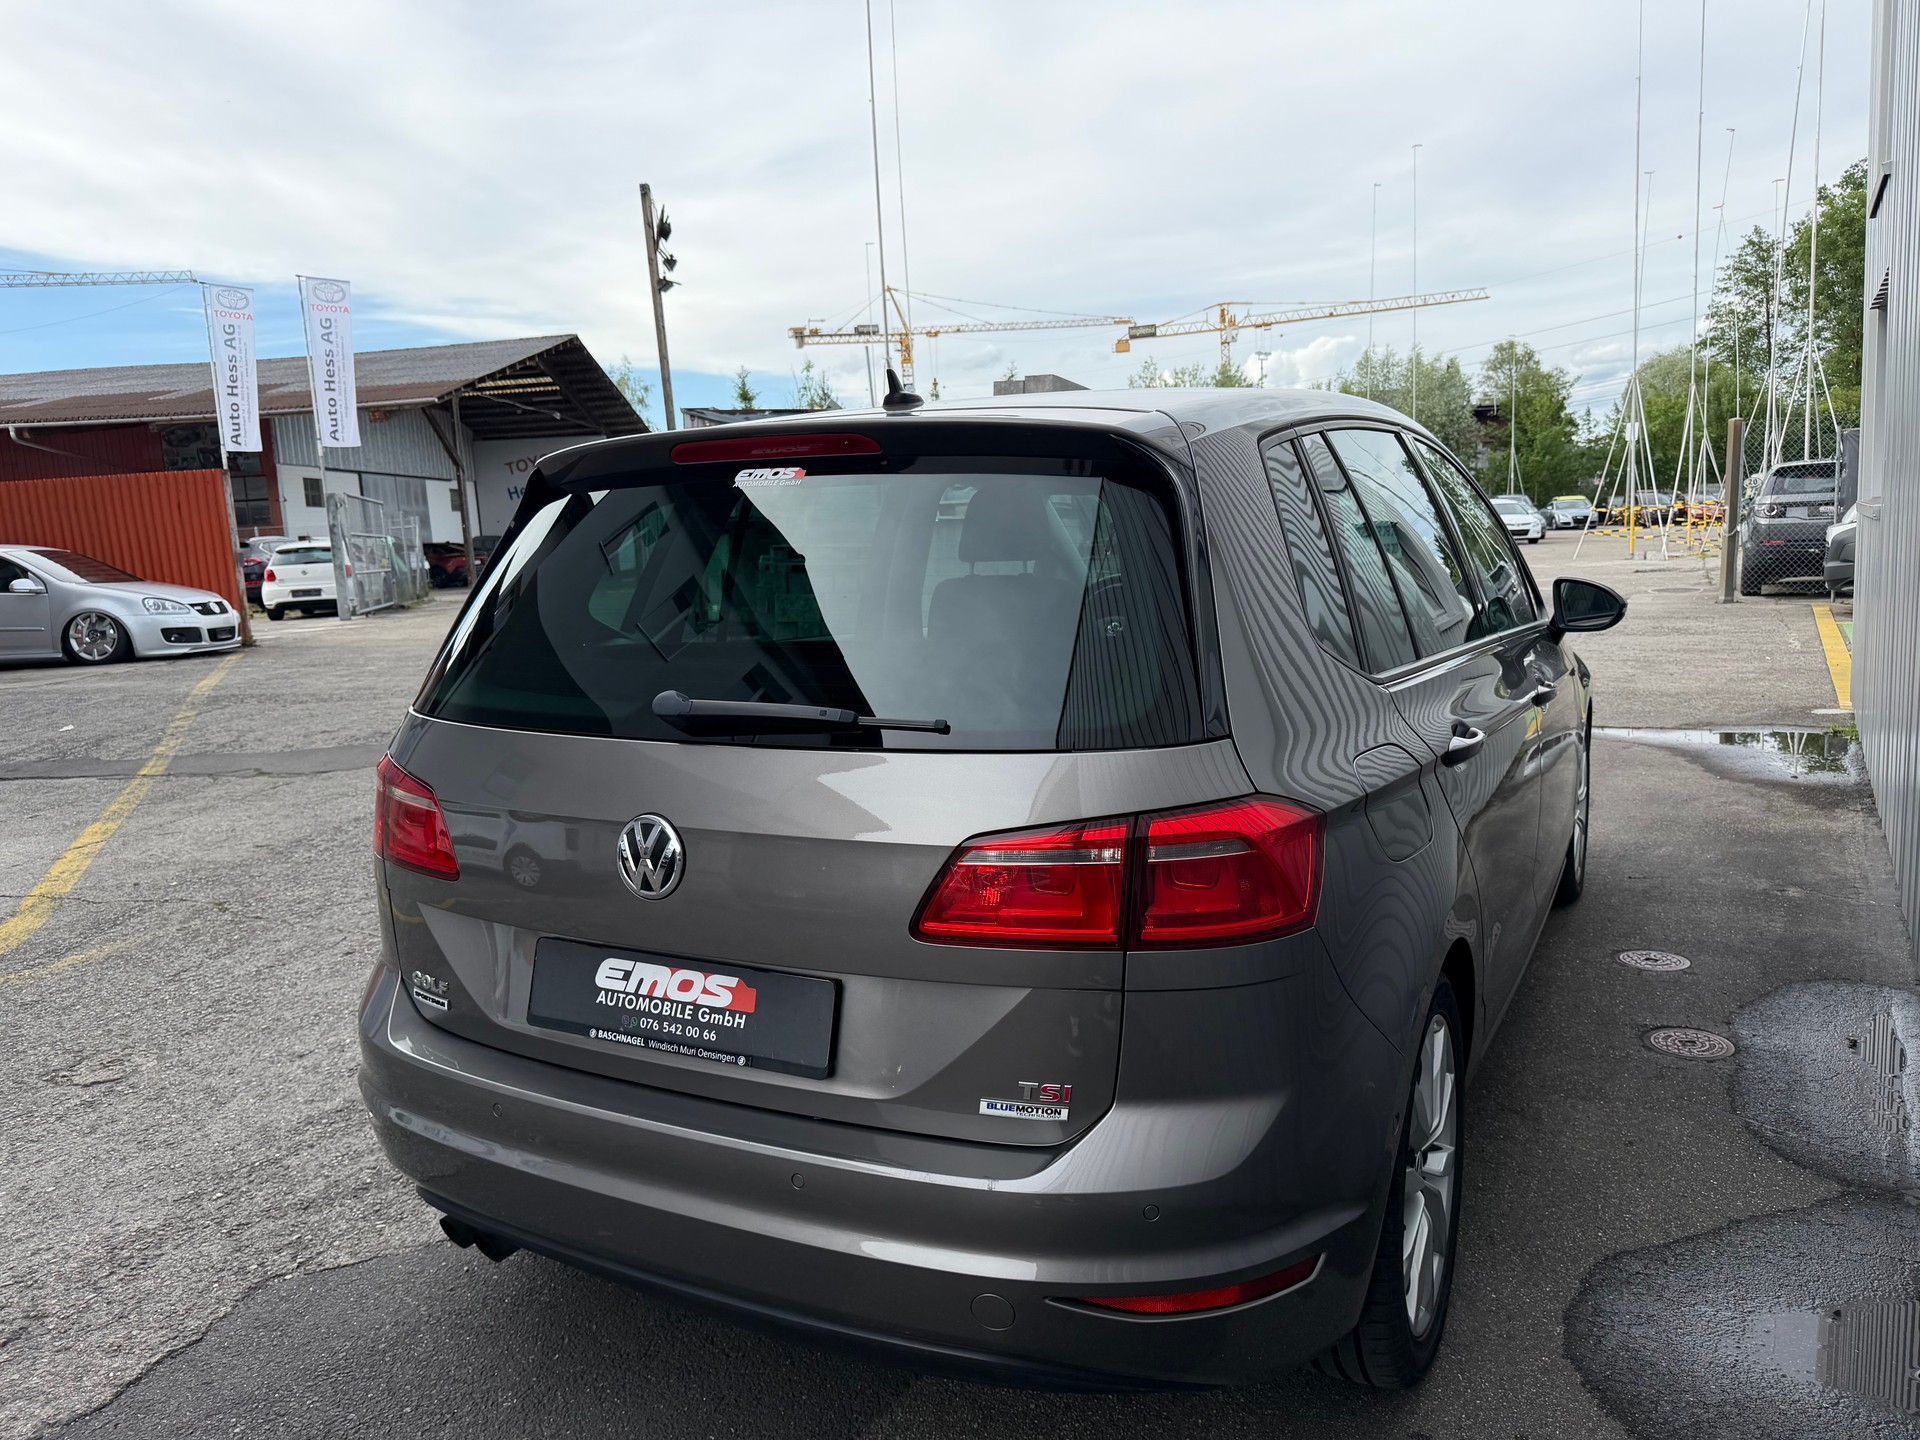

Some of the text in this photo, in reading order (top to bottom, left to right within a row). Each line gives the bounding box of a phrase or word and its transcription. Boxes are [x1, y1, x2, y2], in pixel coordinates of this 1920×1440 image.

[214, 310, 253, 321] TOYOTA
[310, 303, 350, 314] TOYOTA
[320, 317, 334, 345] AG
[324, 348, 336, 392] Hess
[223, 323, 242, 447] Auto Hess AG
[328, 397, 340, 442] Auto
[504, 454, 548, 475] TOY
[732, 479, 778, 488] AUTOMOBILE
[412, 970, 449, 994] GOLF
[596, 990, 746, 1029] AUTOMOBILE GmbH
[640, 1017, 717, 1042] 076 542 00 66
[598, 1030, 736, 1063] BASCHNAGEL Windisch Muri Oensingen
[1018, 1081, 1072, 1103] TSI
[986, 1101, 1062, 1116] BLUEMOTION
[1016, 1112, 1061, 1120] TECHNOLOGY
